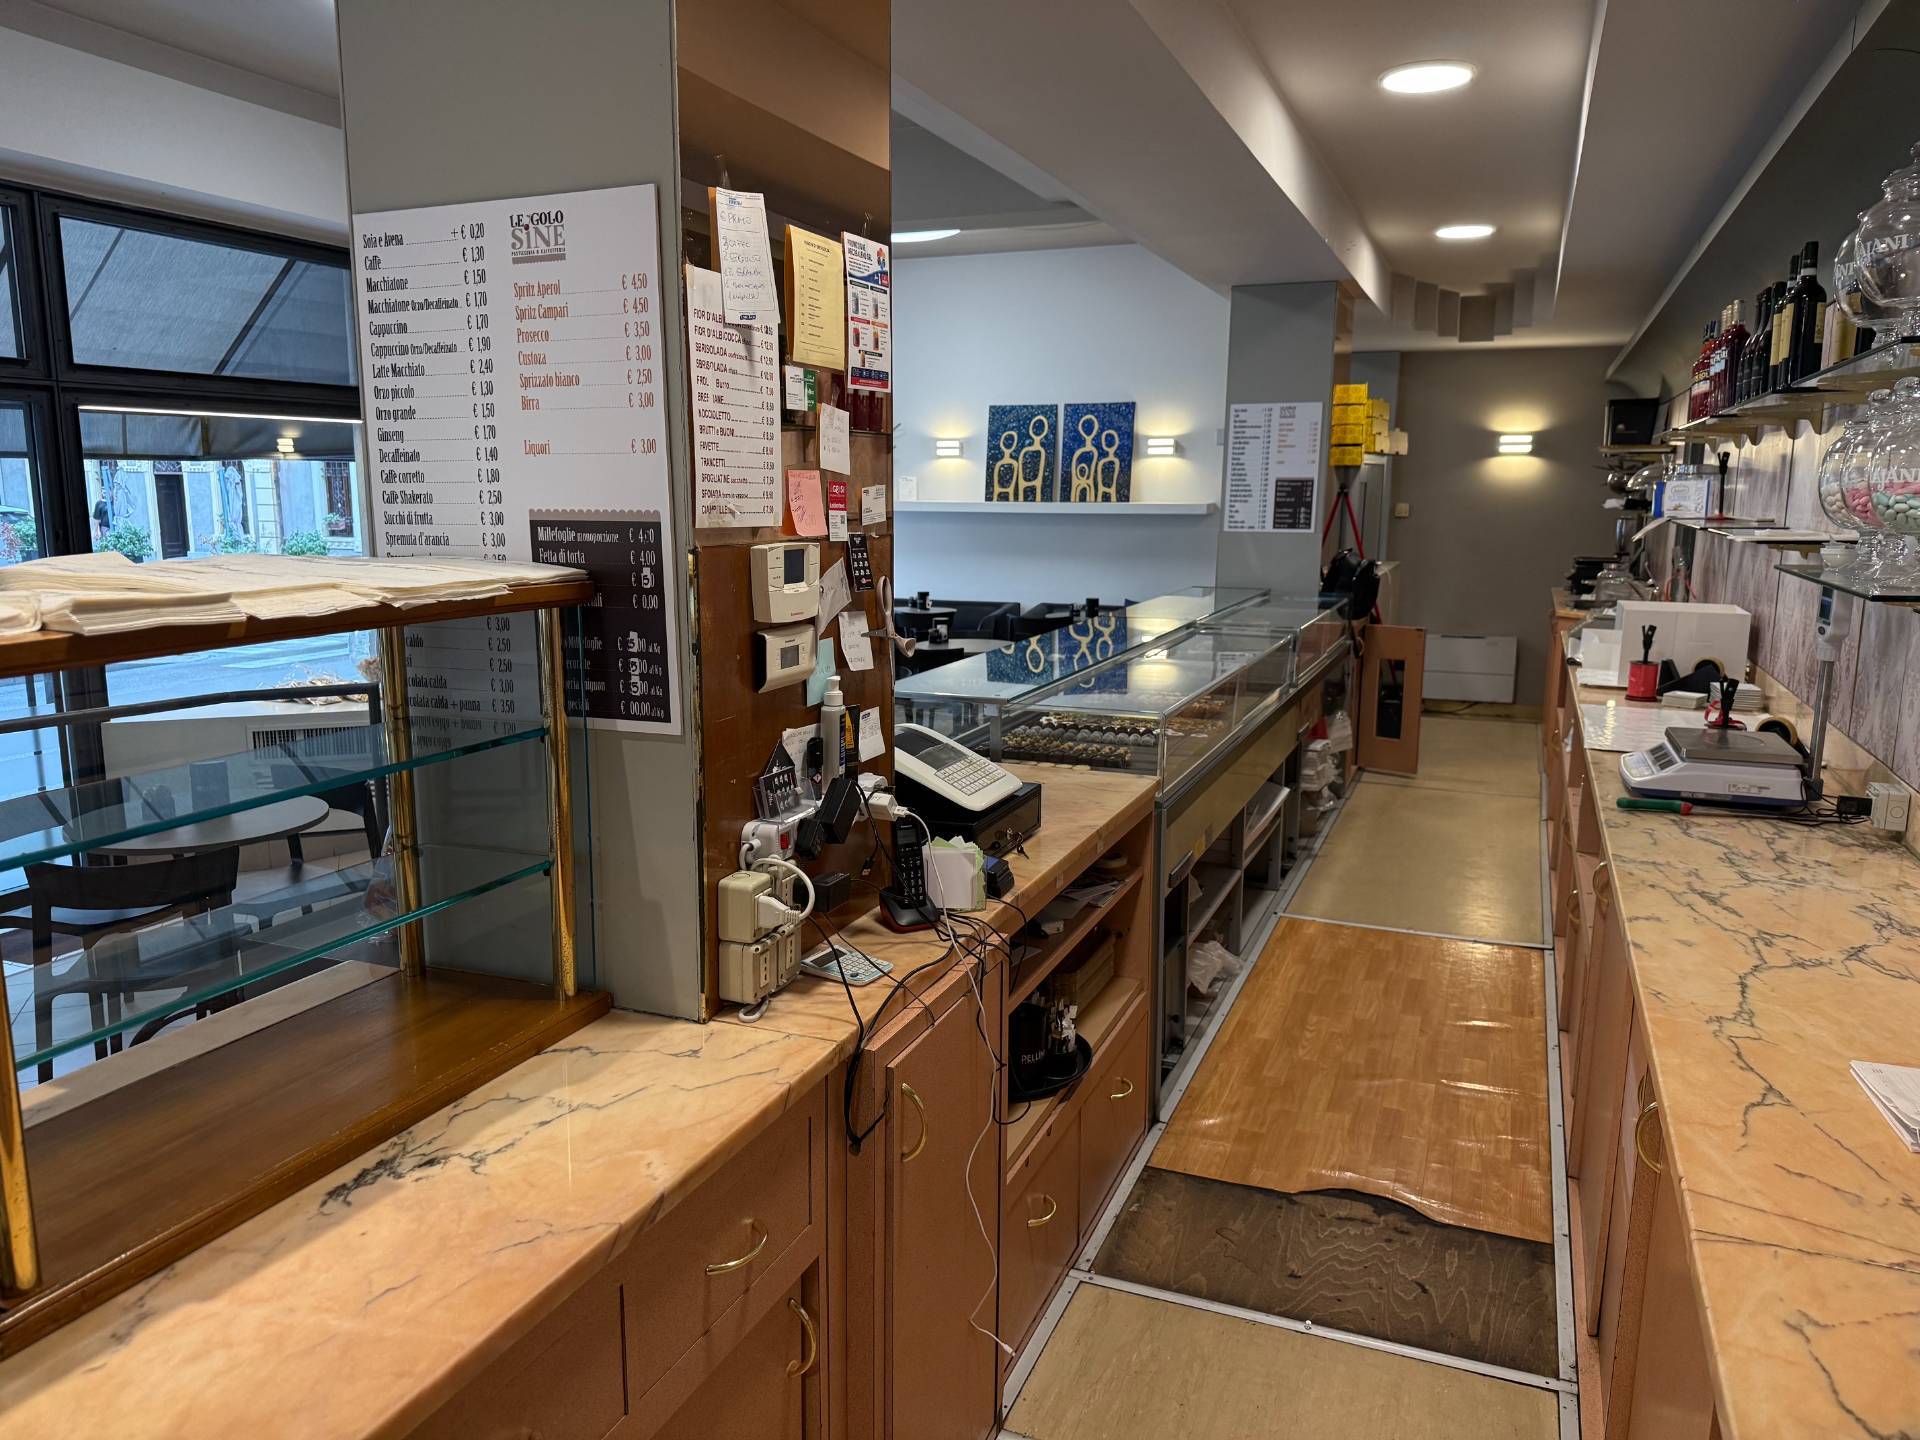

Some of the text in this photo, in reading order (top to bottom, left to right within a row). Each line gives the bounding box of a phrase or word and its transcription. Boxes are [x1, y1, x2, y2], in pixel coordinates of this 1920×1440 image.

[470, 222, 485, 240] 0,20
[510, 214, 524, 228] LE
[364, 255, 382, 271] Caffè
[471, 246, 485, 264] 1,30
[366, 276, 409, 293] Macchiatone
[472, 268, 486, 286] 1,50
[513, 282, 536, 300] Spritz
[537, 280, 561, 298] Aperol
[632, 272, 648, 291] 4,50
[368, 298, 410, 314] Macchiatone
[474, 291, 488, 309] 1,70
[514, 304, 536, 322] Spritz
[538, 302, 569, 321] Campari
[632, 296, 649, 316] 4,50
[369, 320, 408, 338] Cappuccino
[476, 314, 490, 332] 1,70
[517, 328, 550, 344] Prosecco
[634, 320, 650, 339] 3,50
[370, 341, 410, 359] Cappuccino
[477, 336, 491, 354] 1,90
[518, 350, 546, 366] Custoza
[635, 344, 652, 362] 3,00
[372, 364, 390, 378] Latte
[391, 362, 426, 378] Macchiato
[478, 358, 494, 376] 2,40
[520, 372, 554, 390] Sprizzato
[555, 372, 580, 387] bianco
[636, 368, 652, 386] 2,50
[374, 386, 390, 400] Orzo
[391, 384, 415, 402] piccolo
[480, 380, 494, 398] 1,30
[522, 395, 540, 411] Birra
[638, 392, 654, 410] 3,00
[375, 406, 392, 421] Orzo
[392, 405, 417, 422] grande
[482, 402, 495, 420] 1,50
[377, 427, 404, 444] Ginseng
[483, 424, 496, 442] 1,70
[378, 448, 421, 463] Decaffeinato
[484, 446, 499, 463] 1,40
[524, 439, 552, 456] Liquori
[640, 438, 657, 456] 3,00
[380, 469, 398, 484] Caffè
[398, 470, 425, 484] corretto
[486, 468, 500, 484] 1,80
[382, 490, 398, 504] Caffè
[400, 490, 434, 504] Shakerato
[488, 490, 502, 506] 2,50
[384, 510, 406, 526] Succhi
[406, 510, 414, 525] di
[414, 511, 434, 526] frutta
[489, 512, 504, 528] 3,00
[386, 532, 418, 548] Spremuta
[418, 532, 450, 546] d'arancia
[491, 532, 506, 549] 3,00
[537, 526, 576, 544] Millefoglie
[539, 548, 558, 563] Fetta
[558, 548, 566, 563] di
[567, 550, 586, 564] torta
